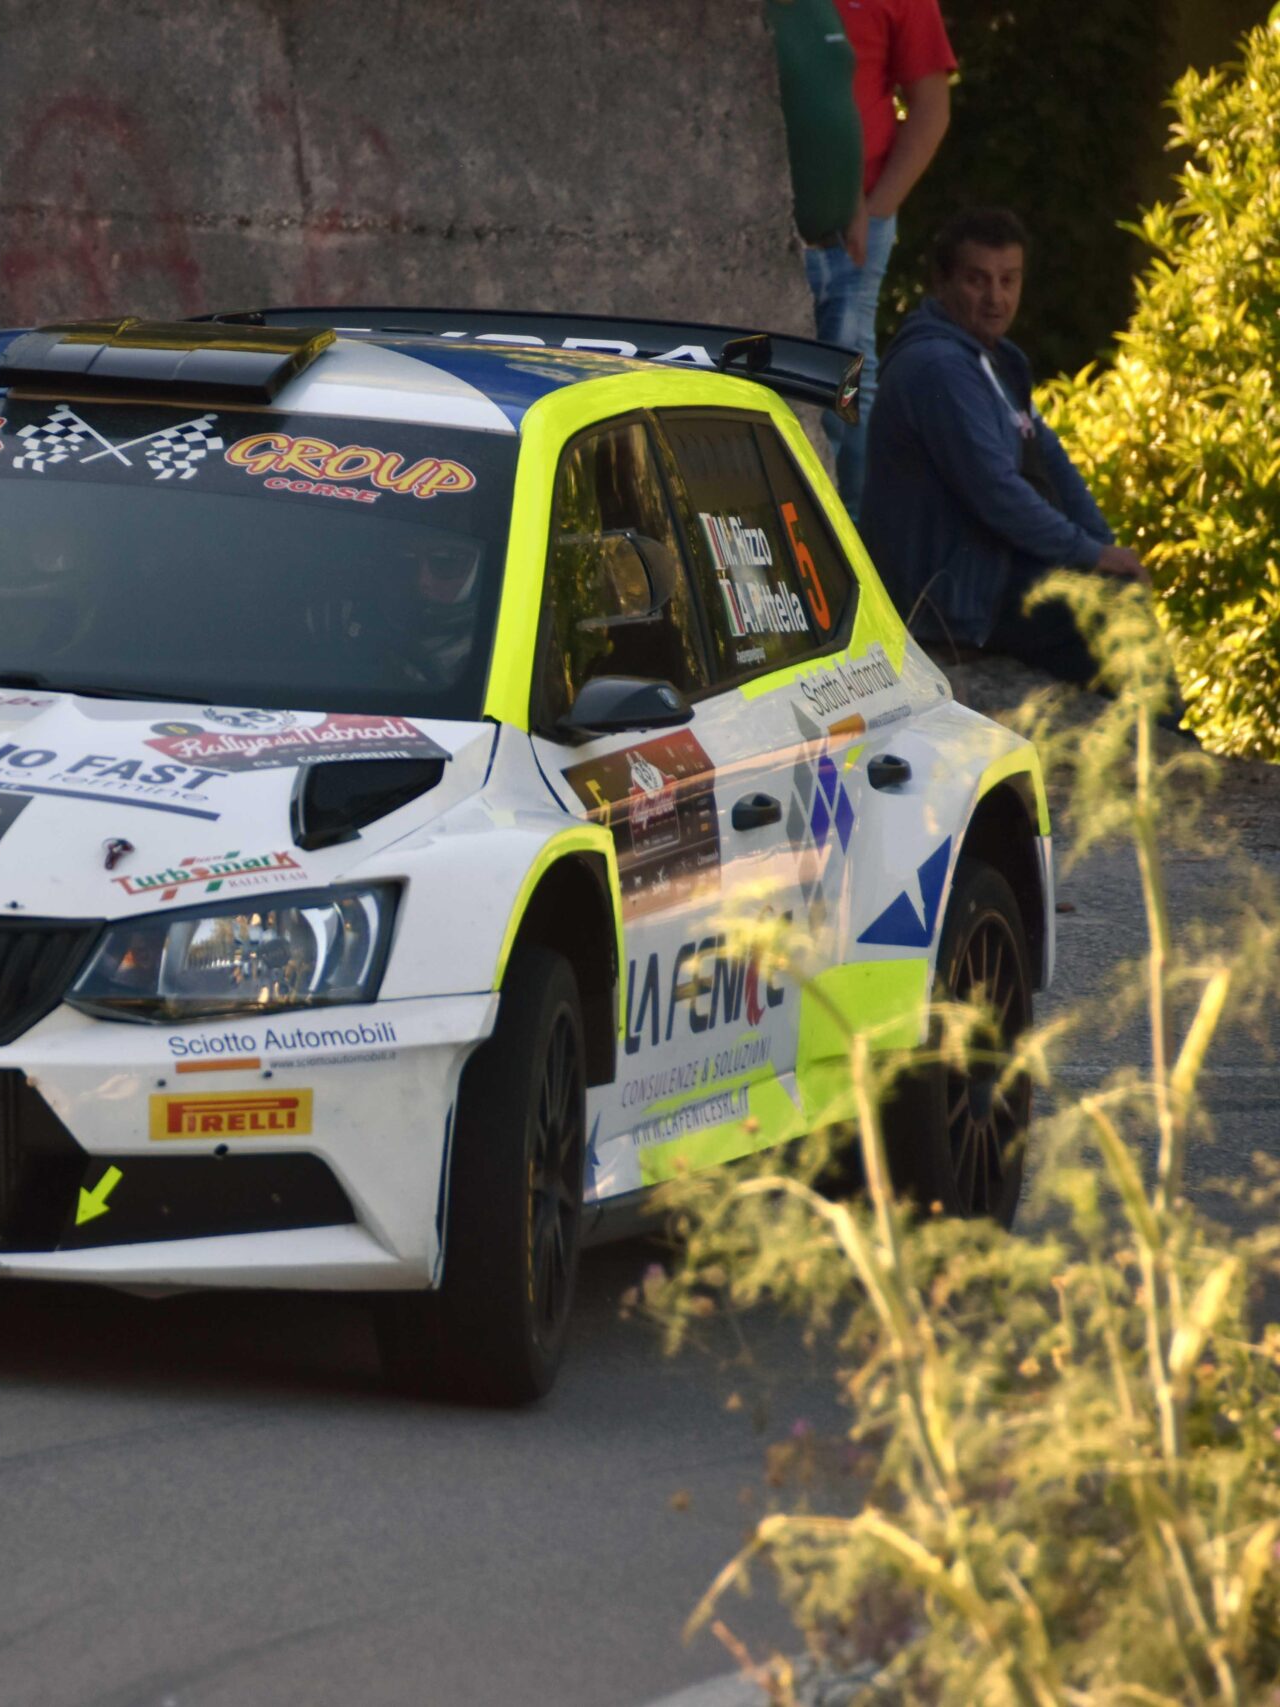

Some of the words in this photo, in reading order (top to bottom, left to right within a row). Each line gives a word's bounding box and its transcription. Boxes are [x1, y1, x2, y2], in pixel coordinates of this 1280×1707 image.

[224, 433, 477, 499] GROUP
[263, 476, 382, 503] CORSE
[781, 502, 831, 632] 5
[800, 673, 851, 717] Sciotto
[169, 734, 271, 757] Rallye
[283, 719, 417, 745] Nebrodi
[64, 754, 228, 792] FAST
[624, 952, 660, 1056] LA
[167, 1033, 257, 1057] Sciotto
[263, 1021, 398, 1051] Automobili
[621, 1059, 700, 1108] CONSULENZE
[712, 1036, 772, 1079] SOLUZIONI
[166, 1096, 300, 1134] PIRELLI
